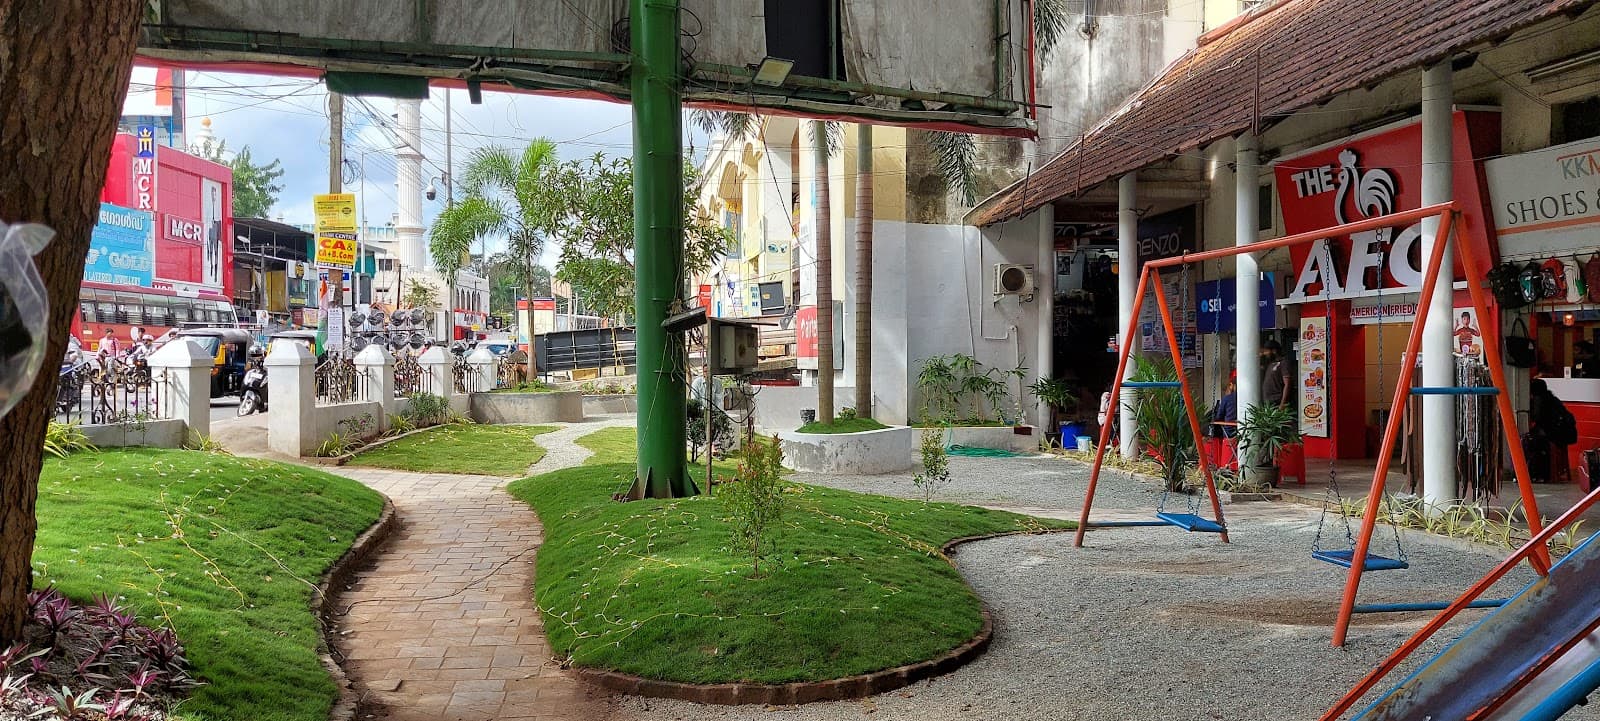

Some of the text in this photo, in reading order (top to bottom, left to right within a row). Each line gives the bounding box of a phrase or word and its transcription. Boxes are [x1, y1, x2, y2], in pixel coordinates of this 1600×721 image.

[138, 158, 152, 209] MCR
[1291, 165, 1335, 198] THE
[1506, 190, 1588, 225] SHOES
[171, 218, 202, 242] MCR
[320, 239, 346, 251] CA
[1351, 305, 1388, 317] AMERICAN
[1390, 304, 1413, 315] FRIED
